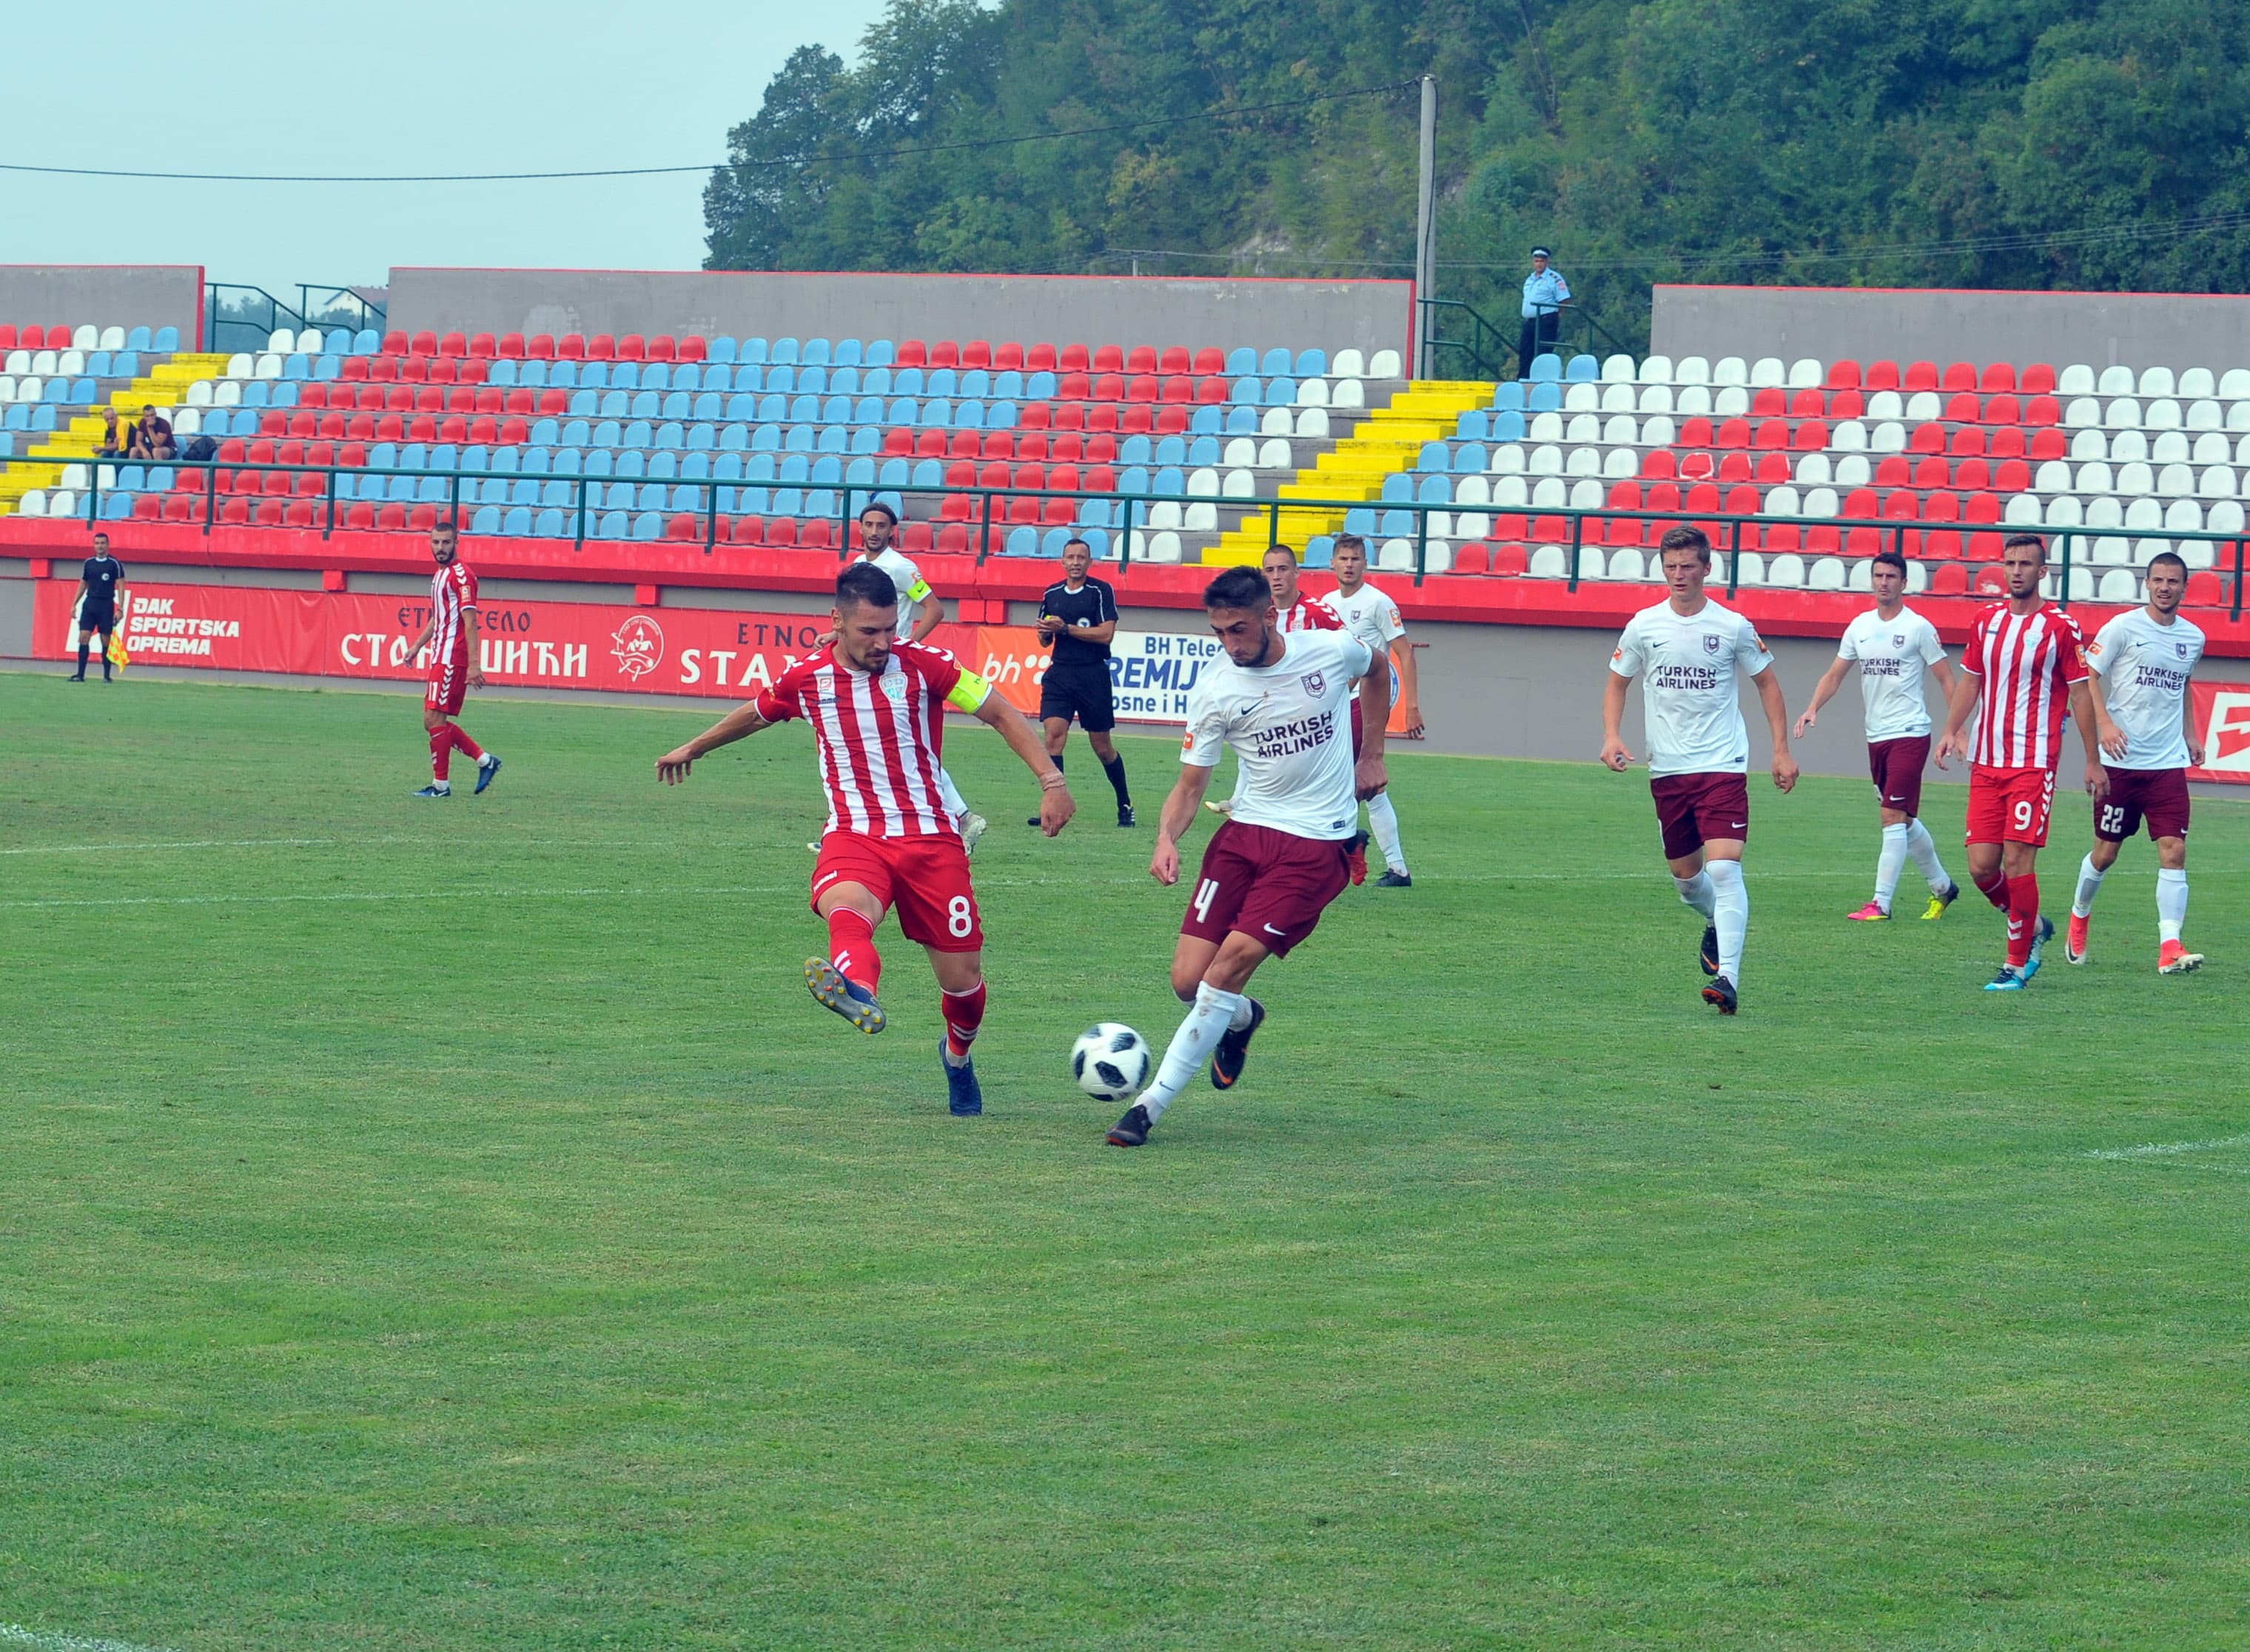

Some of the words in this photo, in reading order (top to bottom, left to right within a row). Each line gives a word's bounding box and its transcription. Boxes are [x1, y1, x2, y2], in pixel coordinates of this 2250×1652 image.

[130, 617, 240, 637] SPORTSKA
[737, 622, 818, 648] ETNO
[126, 635, 211, 655] OPREMA
[1145, 637, 1170, 655] BH
[981, 652, 1021, 685] bh
[1104, 657, 1209, 691] REMIJ
[1656, 665, 1716, 678] TURKISH
[2138, 665, 2184, 682] TURKISH
[1656, 677, 1716, 690] AIRLINES
[2135, 676, 2183, 691] AIRLINES
[1111, 694, 1156, 712] osne
[1251, 710, 1333, 745] TURKISH
[1257, 725, 1334, 758] AIRLINES
[2014, 801, 2032, 830] 9
[2100, 804, 2124, 833] 22
[1194, 878, 1220, 924] 4
[948, 896, 973, 938] 8
